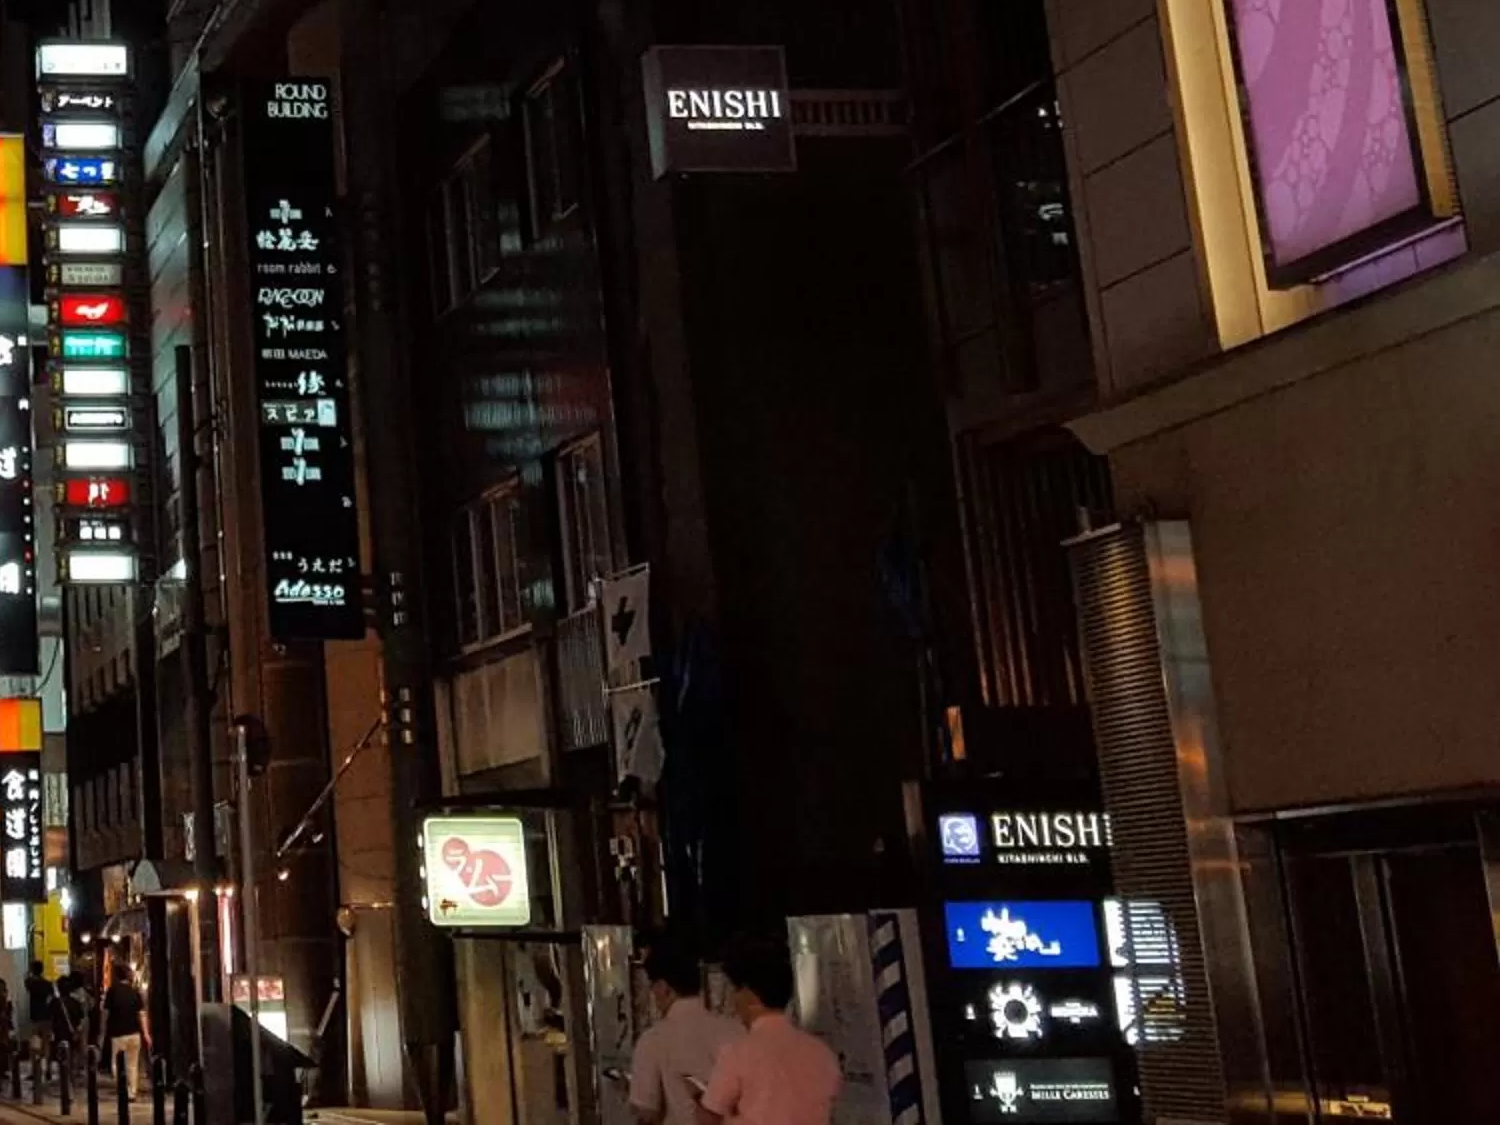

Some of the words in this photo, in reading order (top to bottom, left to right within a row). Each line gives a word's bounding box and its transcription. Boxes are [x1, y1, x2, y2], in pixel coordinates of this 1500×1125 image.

[275, 83, 327, 100] ROUND
[267, 101, 328, 119] BUILDING
[667, 89, 782, 118] ENISHI
[298, 557, 344, 573] うえだ
